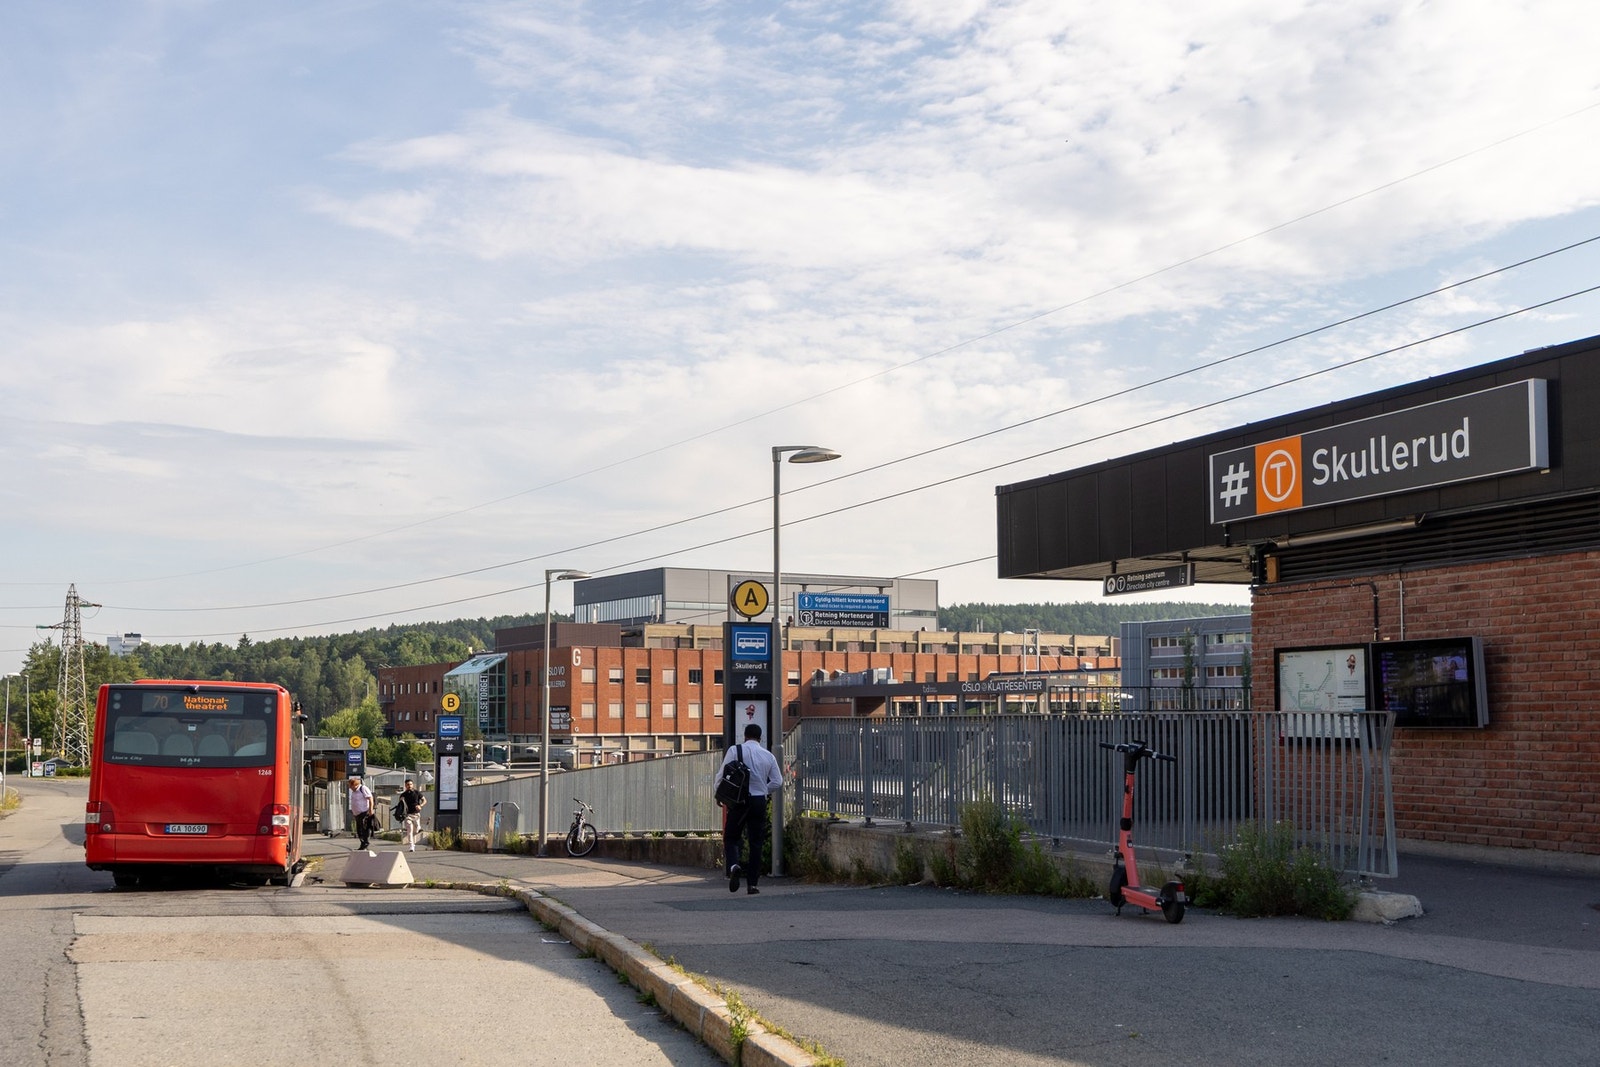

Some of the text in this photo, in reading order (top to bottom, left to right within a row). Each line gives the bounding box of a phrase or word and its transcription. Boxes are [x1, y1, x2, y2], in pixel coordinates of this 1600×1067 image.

[1312, 416, 1470, 486] Skullerud
[1126, 582, 1146, 590] Direction
[744, 588, 759, 606] A
[572, 648, 581, 666] G
[962, 680, 1032, 692] OSLO KLATRESENTER
[153, 696, 229, 709] 70 National-
[447, 698, 455, 707] B
[480, 674, 488, 723] HELSETORGET
